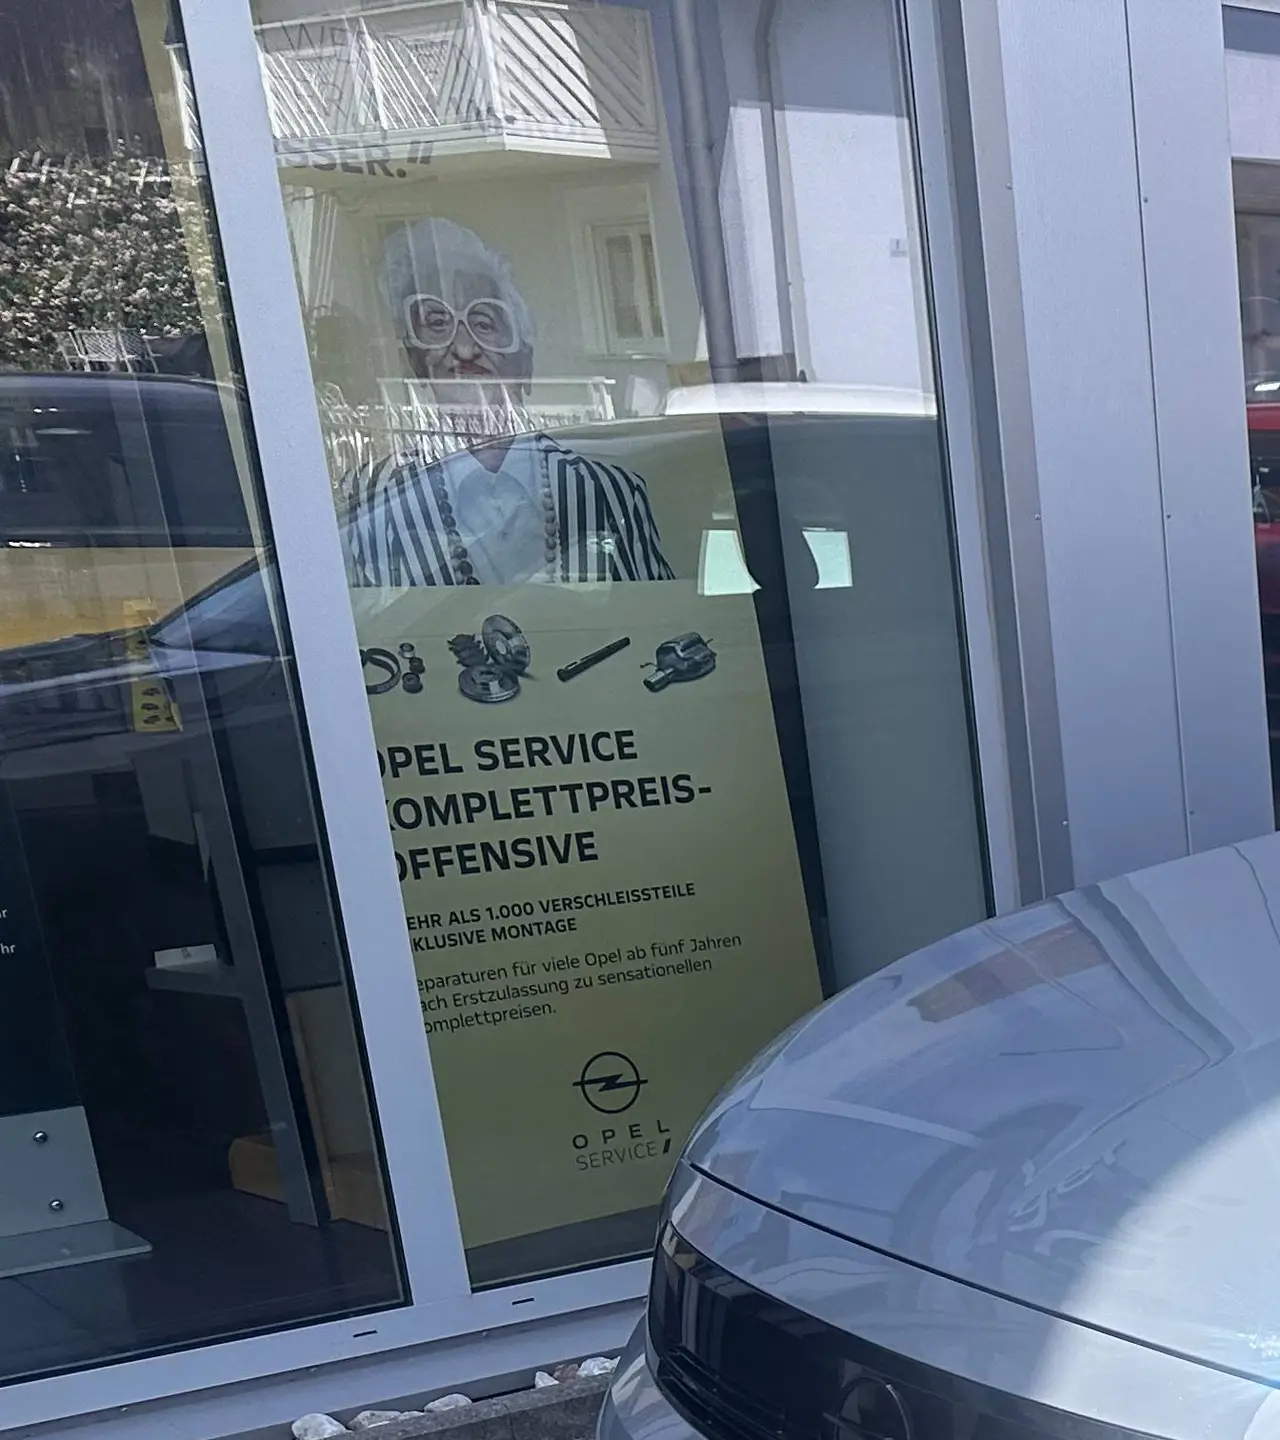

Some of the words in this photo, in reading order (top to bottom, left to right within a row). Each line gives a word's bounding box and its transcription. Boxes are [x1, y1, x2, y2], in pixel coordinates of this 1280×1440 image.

[377, 743, 464, 778] PEL
[474, 730, 638, 771] SERVICE
[386, 774, 712, 831] OMPLETTPREIS-
[406, 913, 443, 931] EHR
[448, 908, 482, 926] ALS
[485, 901, 535, 921] 1.000
[539, 882, 696, 913] VERSCHLEISSTEILE
[410, 929, 487, 952] KLUSIVE
[491, 917, 578, 942] MONTAGE
[512, 961, 537, 977] für
[542, 955, 580, 973] viele
[584, 948, 622, 968] Opel
[627, 945, 647, 961] ab
[651, 940, 686, 958] fünf
[690, 934, 742, 953] Jahren
[420, 995, 448, 1013] ach
[452, 979, 570, 1008] Erstzulassung
[574, 976, 594, 990] zu
[597, 957, 713, 986] sensationellen
[572, 1119, 671, 1150] OPEL
